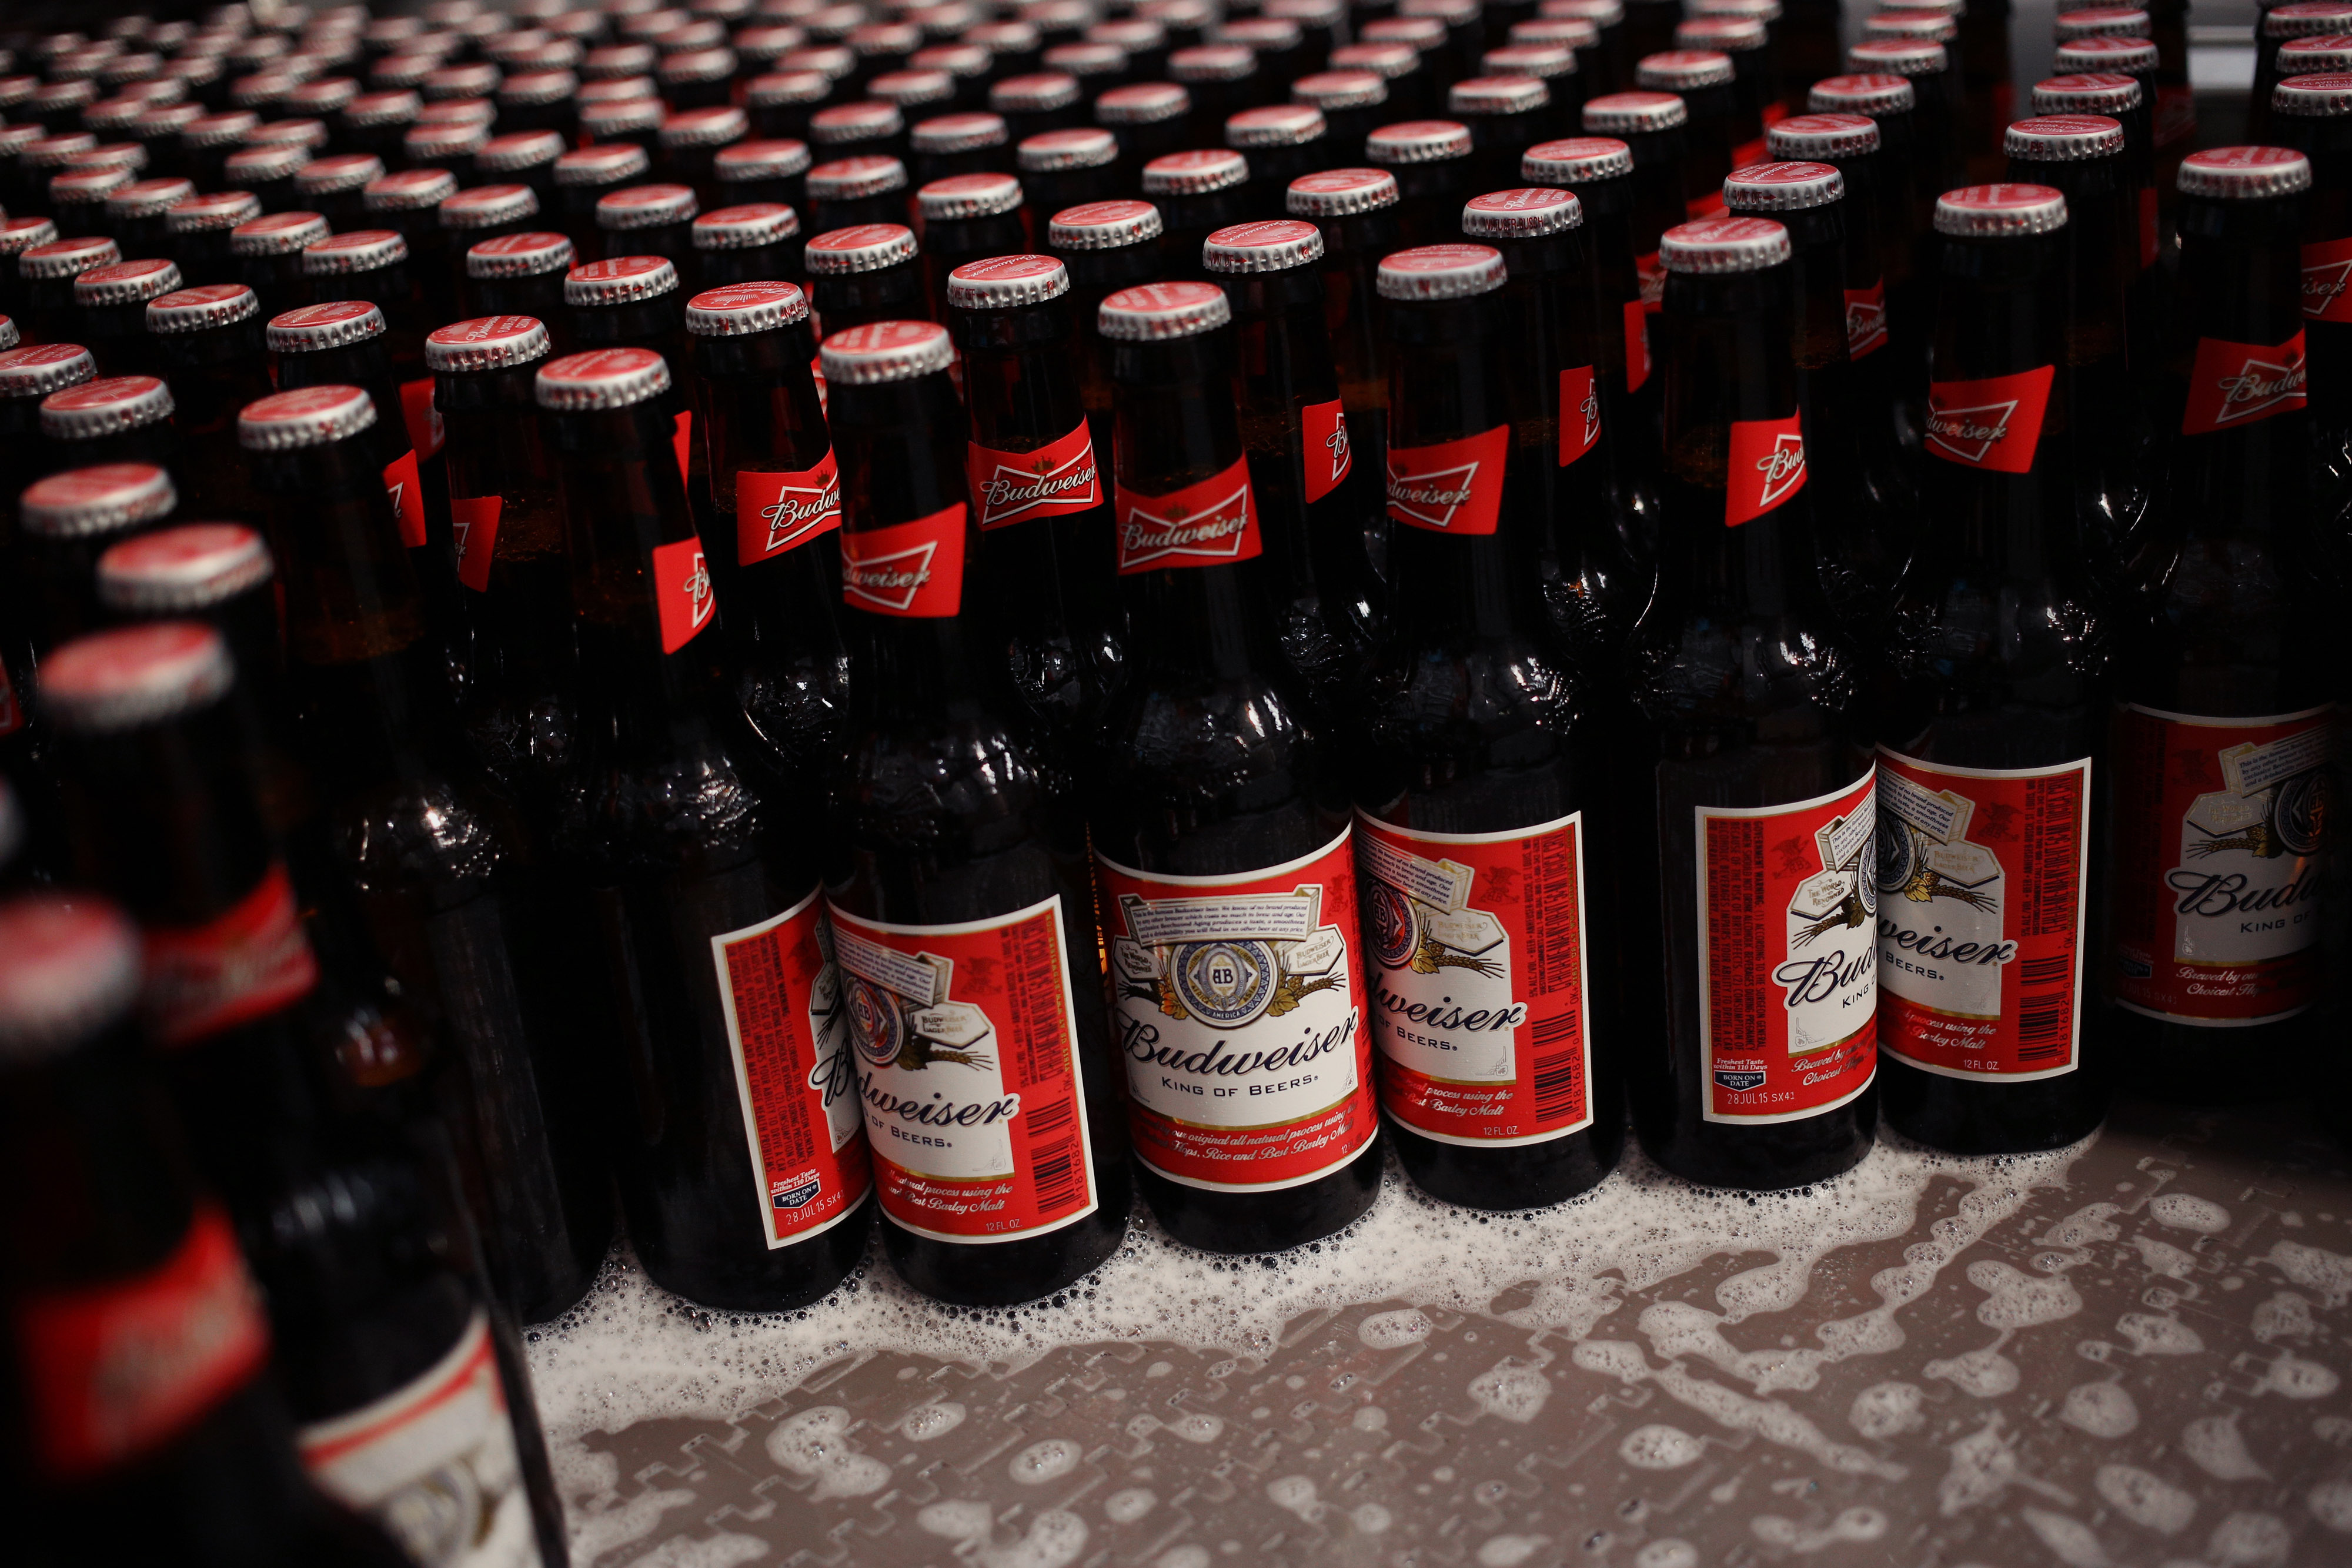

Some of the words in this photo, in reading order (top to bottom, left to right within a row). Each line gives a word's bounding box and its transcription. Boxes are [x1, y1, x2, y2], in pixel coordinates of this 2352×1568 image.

[980, 464, 1095, 507] Budweiser
[1119, 512, 1248, 550] Budweiser
[2240, 918, 2285, 934] KING
[2176, 967, 2226, 982] Brewed
[2226, 970, 2240, 984] by
[1842, 983, 1869, 1009] KING
[2187, 982, 2235, 997] Choicest
[1756, 988, 1765, 1018] SURGEON
[1945, 1022, 1976, 1036] using
[1979, 1024, 1997, 1035] the
[1117, 1007, 1357, 1076] Budweiser
[1950, 1037, 1986, 1049] Malt
[1791, 1050, 1833, 1072] Brewed
[1833, 1049, 1845, 1064] by
[1803, 1066, 1842, 1086] Choicest
[1162, 1076, 1204, 1095] KING
[1214, 1088, 1238, 1097] OF
[1425, 1086, 1461, 1100] process
[1463, 1091, 1494, 1104] using
[1495, 1089, 1514, 1100] the
[1429, 1099, 1468, 1117] Barley
[1469, 1103, 1505, 1116] Malt
[1189, 1132, 1229, 1145] original
[1230, 1134, 1246, 1145] all
[1246, 1128, 1288, 1145] natural
[1288, 1121, 1323, 1141] process
[1484, 1126, 1492, 1135] 12
[1202, 1147, 1232, 1161] Rice
[1233, 1151, 1255, 1161] and
[1258, 1144, 1289, 1160] Best
[1291, 1134, 1330, 1155] Barley
[771, 1183, 792, 1193] within
[793, 1179, 804, 1187] 110
[805, 1172, 820, 1183] Days
[773, 1175, 799, 1188] Freshest
[800, 1168, 816, 1178] Taste
[782, 1190, 801, 1202] BORN
[801, 1186, 812, 1195] ON
[925, 1184, 960, 1197] process
[962, 1185, 993, 1199] using
[995, 1182, 1013, 1193] the
[790, 1195, 808, 1206] DATE
[928, 1197, 968, 1215] Barley
[969, 1199, 1005, 1213] Malt
[985, 1222, 994, 1231] 12
